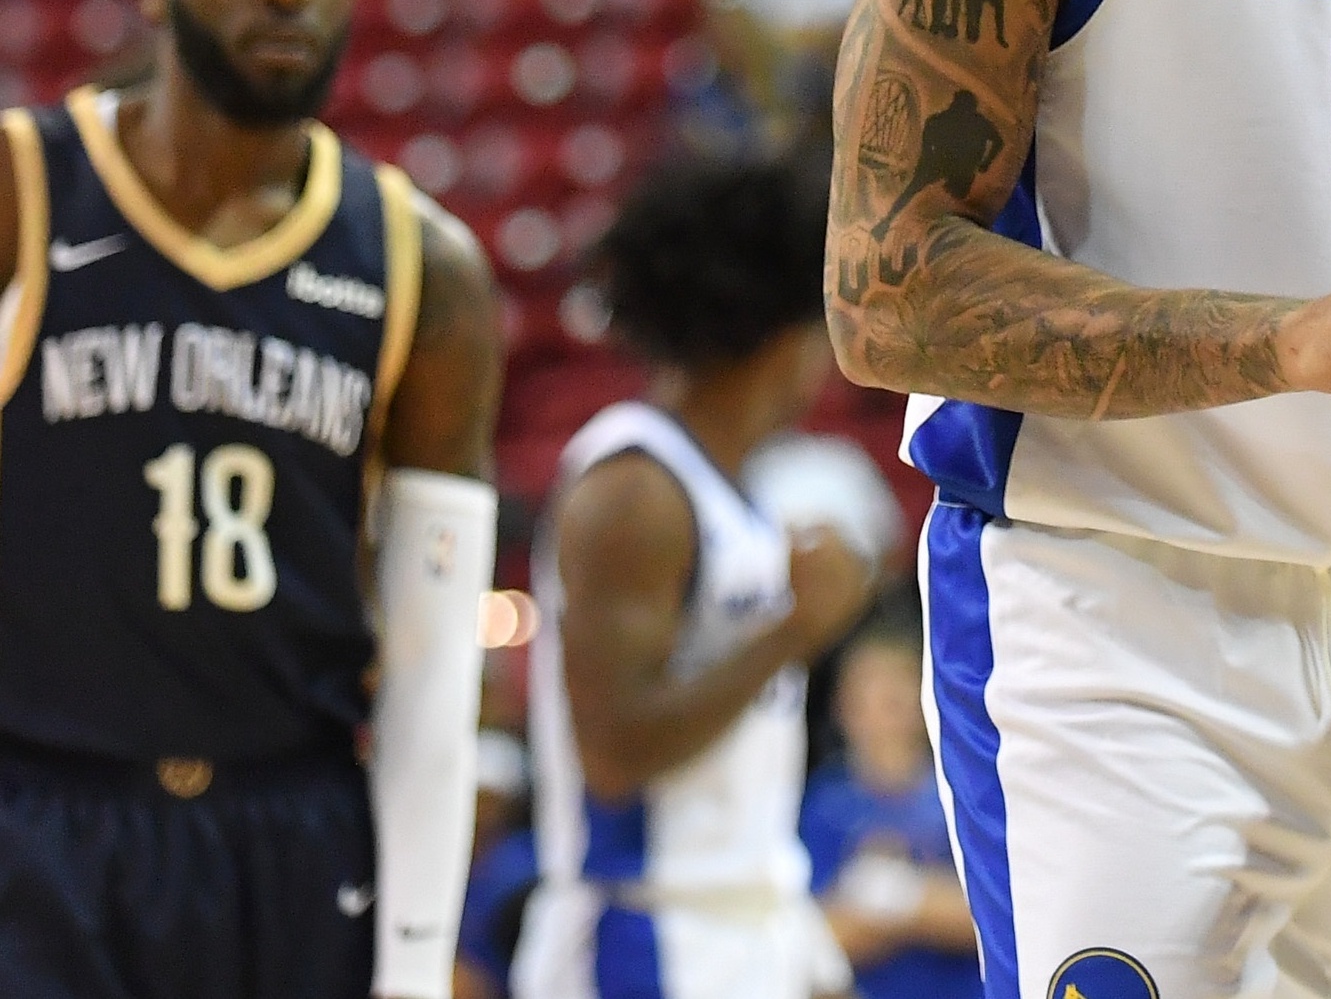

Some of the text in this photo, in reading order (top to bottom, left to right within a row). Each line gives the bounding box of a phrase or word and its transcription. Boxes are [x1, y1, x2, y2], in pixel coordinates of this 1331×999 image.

[41, 321, 372, 457] NEW ORLEANS
[144, 442, 278, 612] 18
